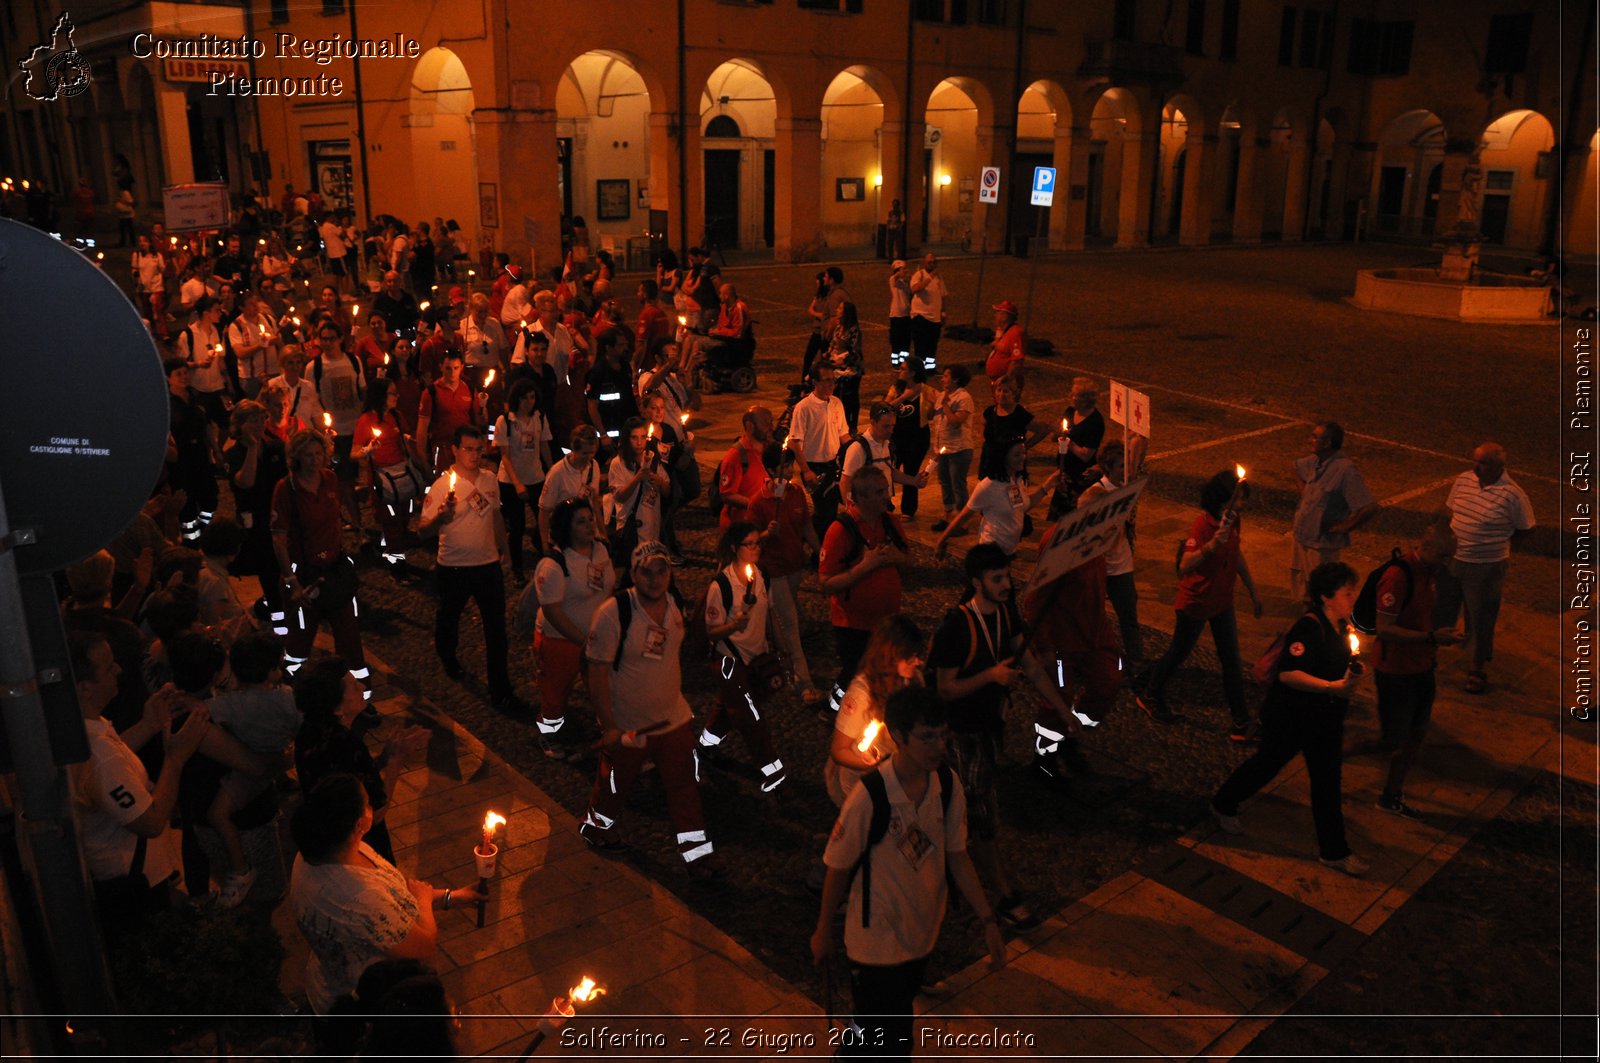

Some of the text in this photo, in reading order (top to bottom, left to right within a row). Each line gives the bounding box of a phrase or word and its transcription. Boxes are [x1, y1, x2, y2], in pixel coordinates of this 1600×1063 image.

[169, 61, 247, 79] LIBRERIA
[1036, 169, 1053, 191] P
[30, 445, 73, 454] CASTIGLIONE
[50, 437, 90, 446] COMUNE DI
[110, 784, 135, 808] 5
